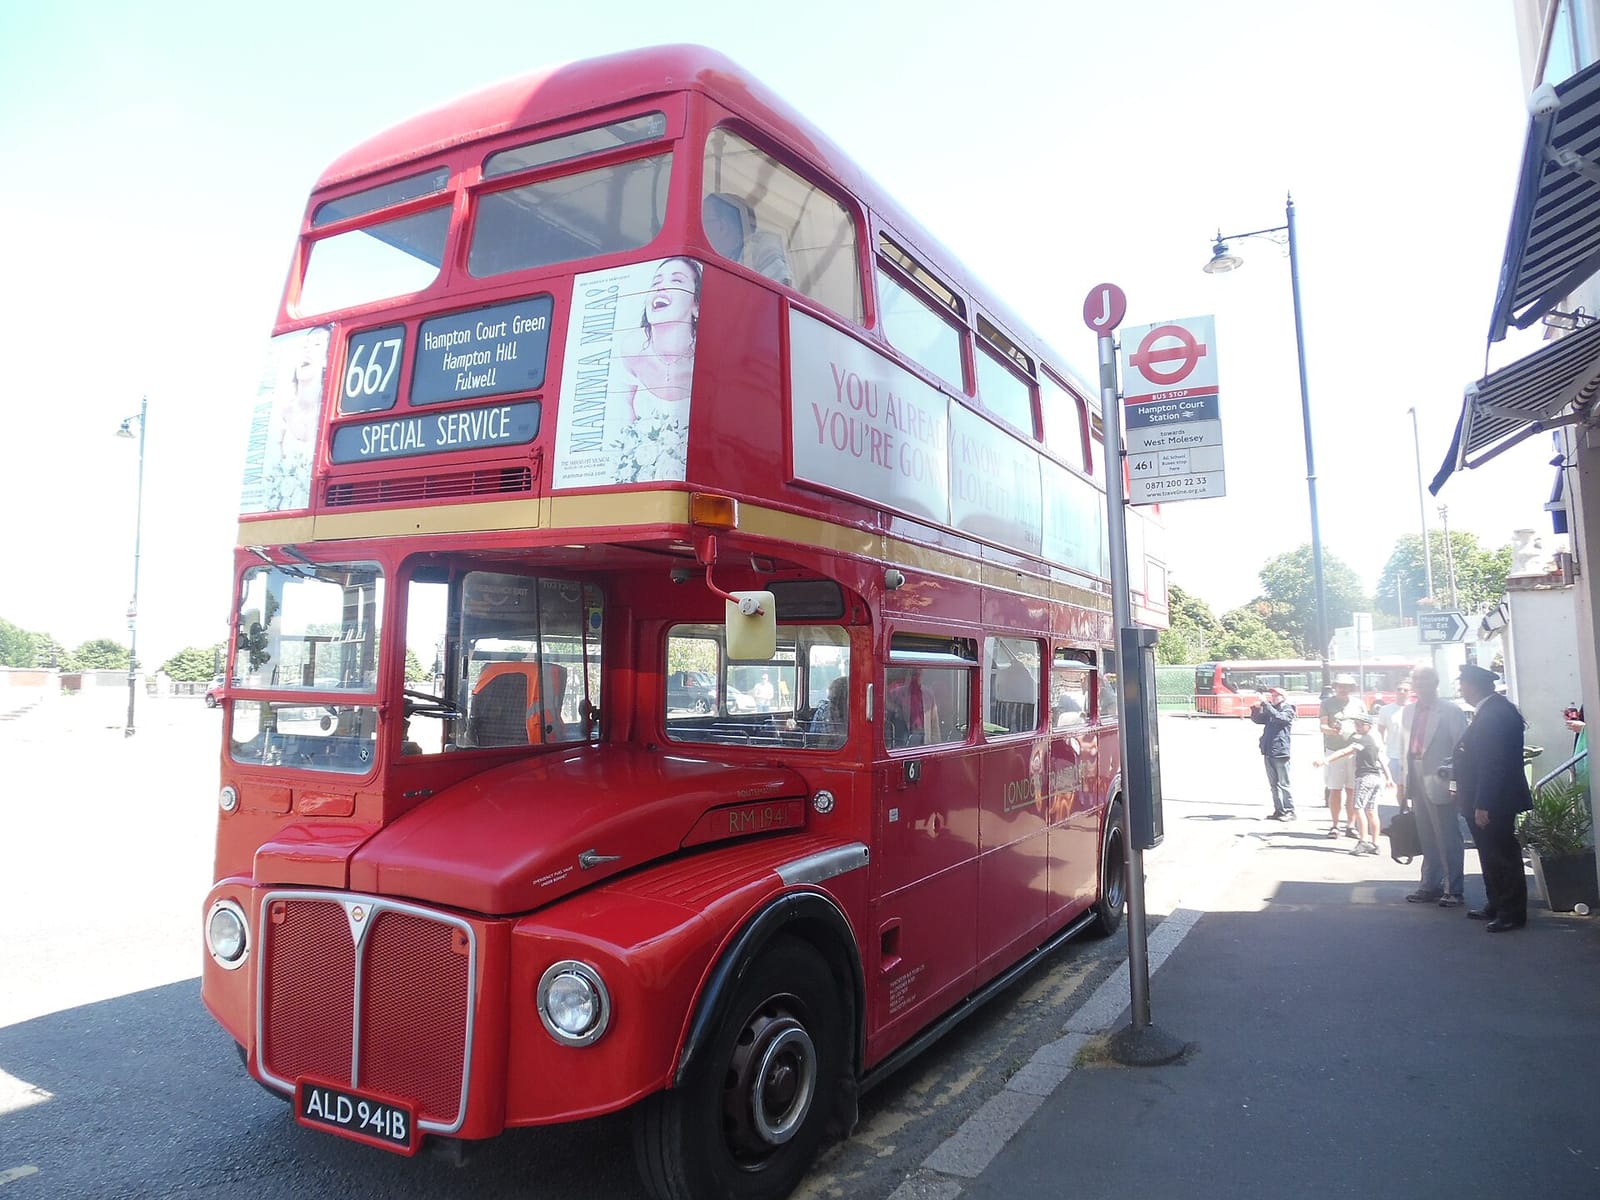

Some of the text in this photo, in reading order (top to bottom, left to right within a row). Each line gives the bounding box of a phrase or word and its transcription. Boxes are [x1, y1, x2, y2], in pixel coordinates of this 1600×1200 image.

[580, 285, 619, 347] MIA!
[1093, 289, 1110, 326] J
[424, 315, 546, 352] Hampton Court Green
[345, 338, 402, 398] 667
[443, 341, 517, 372] Hampton Hill
[454, 368, 497, 392] Fulwell
[1152, 390, 1188, 401] BUS STOP
[569, 348, 612, 455] MAMMA
[1138, 400, 1205, 415] Hampton Court
[1149, 412, 1180, 422] Station
[360, 407, 511, 455] SPECIAL SERVICE
[830, 361, 878, 418] YOU
[962, 432, 1001, 477] KNOW
[811, 402, 894, 470] YOU'RE
[900, 441, 944, 489] GONN
[959, 469, 992, 510] LOVE
[1143, 435, 1204, 447] West Molesey
[1134, 461, 1153, 471] 461
[1145, 481, 1164, 490] 0871
[1166, 480, 1182, 488] 200
[1196, 477, 1207, 485] 33
[909, 762, 915, 779] 6
[729, 807, 788, 833] RM 1941
[307, 1089, 406, 1139] ALD 941B
